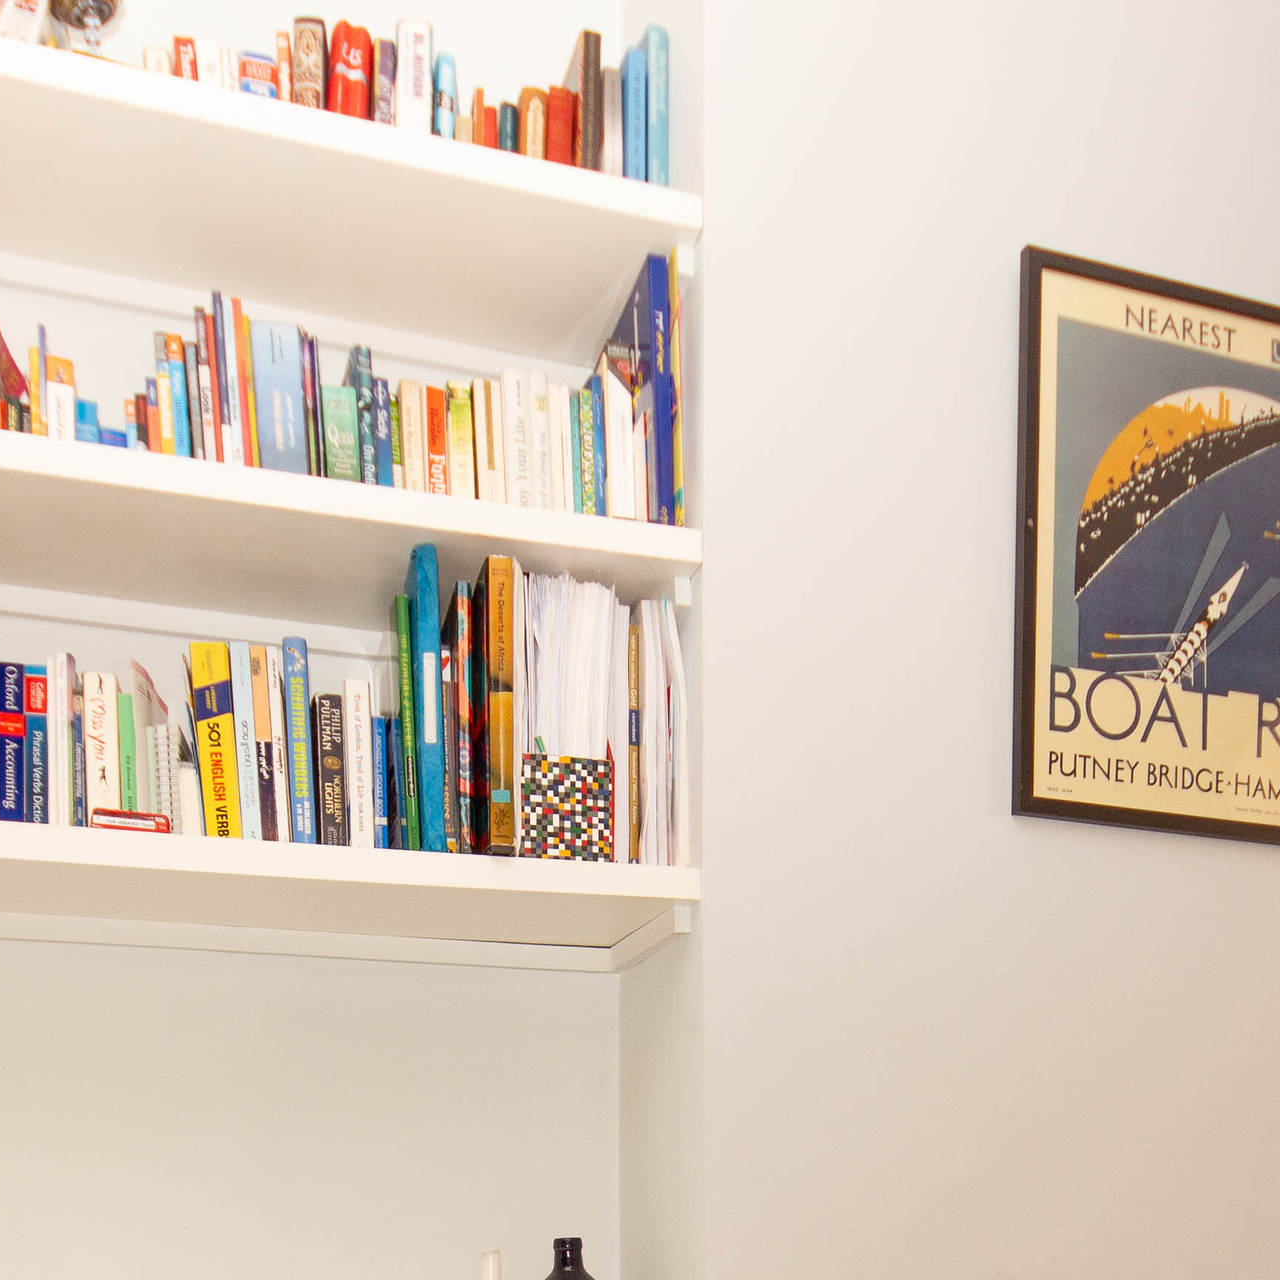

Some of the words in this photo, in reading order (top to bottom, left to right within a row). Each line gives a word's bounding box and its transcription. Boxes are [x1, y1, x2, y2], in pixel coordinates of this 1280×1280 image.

[1124, 304, 1237, 353] NEAREST
[375, 408, 388, 439] Sicily
[497, 582, 505, 598] The
[497, 600, 505, 633] Deserts
[497, 645, 506, 672] Africa
[4, 665, 20, 710] Oxford
[290, 677, 306, 739] SCIENTIFIC
[320, 699, 332, 750] PULLMAN
[330, 708, 342, 744] PHILIP
[1048, 664, 1209, 752] BOAT
[31, 730, 44, 766] Phrasal
[207, 721, 221, 748] 501
[1, 738, 20, 809] Accounting
[32, 767, 44, 793] Verbs
[209, 752, 227, 801] ENGLISH
[293, 741, 309, 798] WONDERS
[1048, 751, 1140, 785] PUTNEY
[1147, 763, 1225, 795] BRIDGE
[32, 795, 44, 824] Dictio
[325, 782, 334, 814] LIGHTS
[333, 775, 343, 823] NORTHERN
[215, 806, 230, 838] VERB
